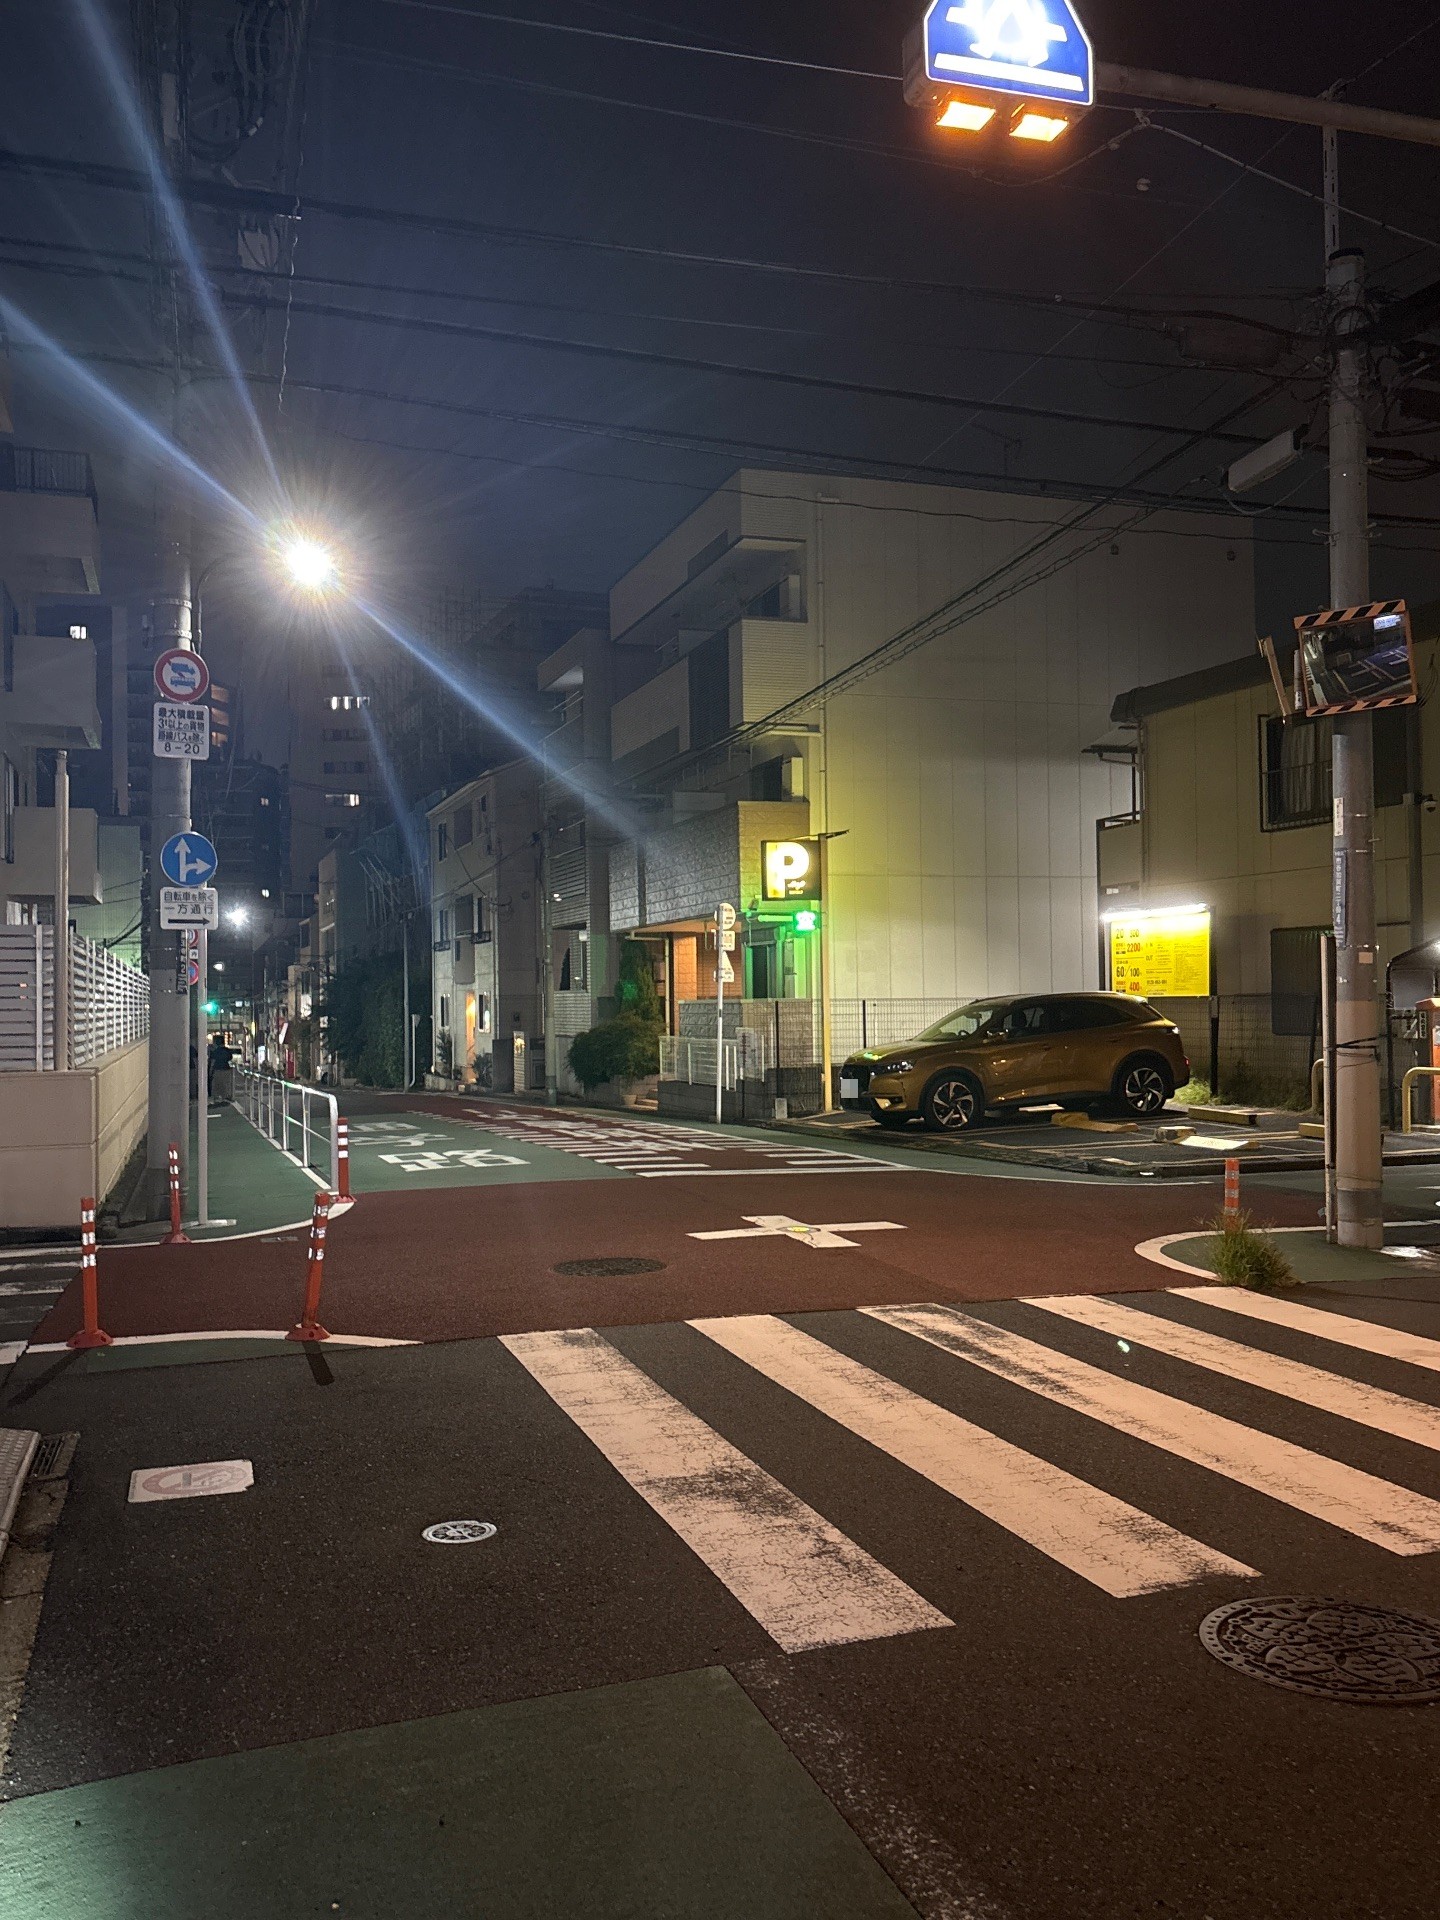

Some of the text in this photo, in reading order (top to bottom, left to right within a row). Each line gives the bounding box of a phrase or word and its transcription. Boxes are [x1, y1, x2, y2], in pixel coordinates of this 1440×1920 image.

[766, 842, 810, 898] P
[164, 891, 214, 902] 自転車を除く
[164, 904, 215, 915] 一方通行
